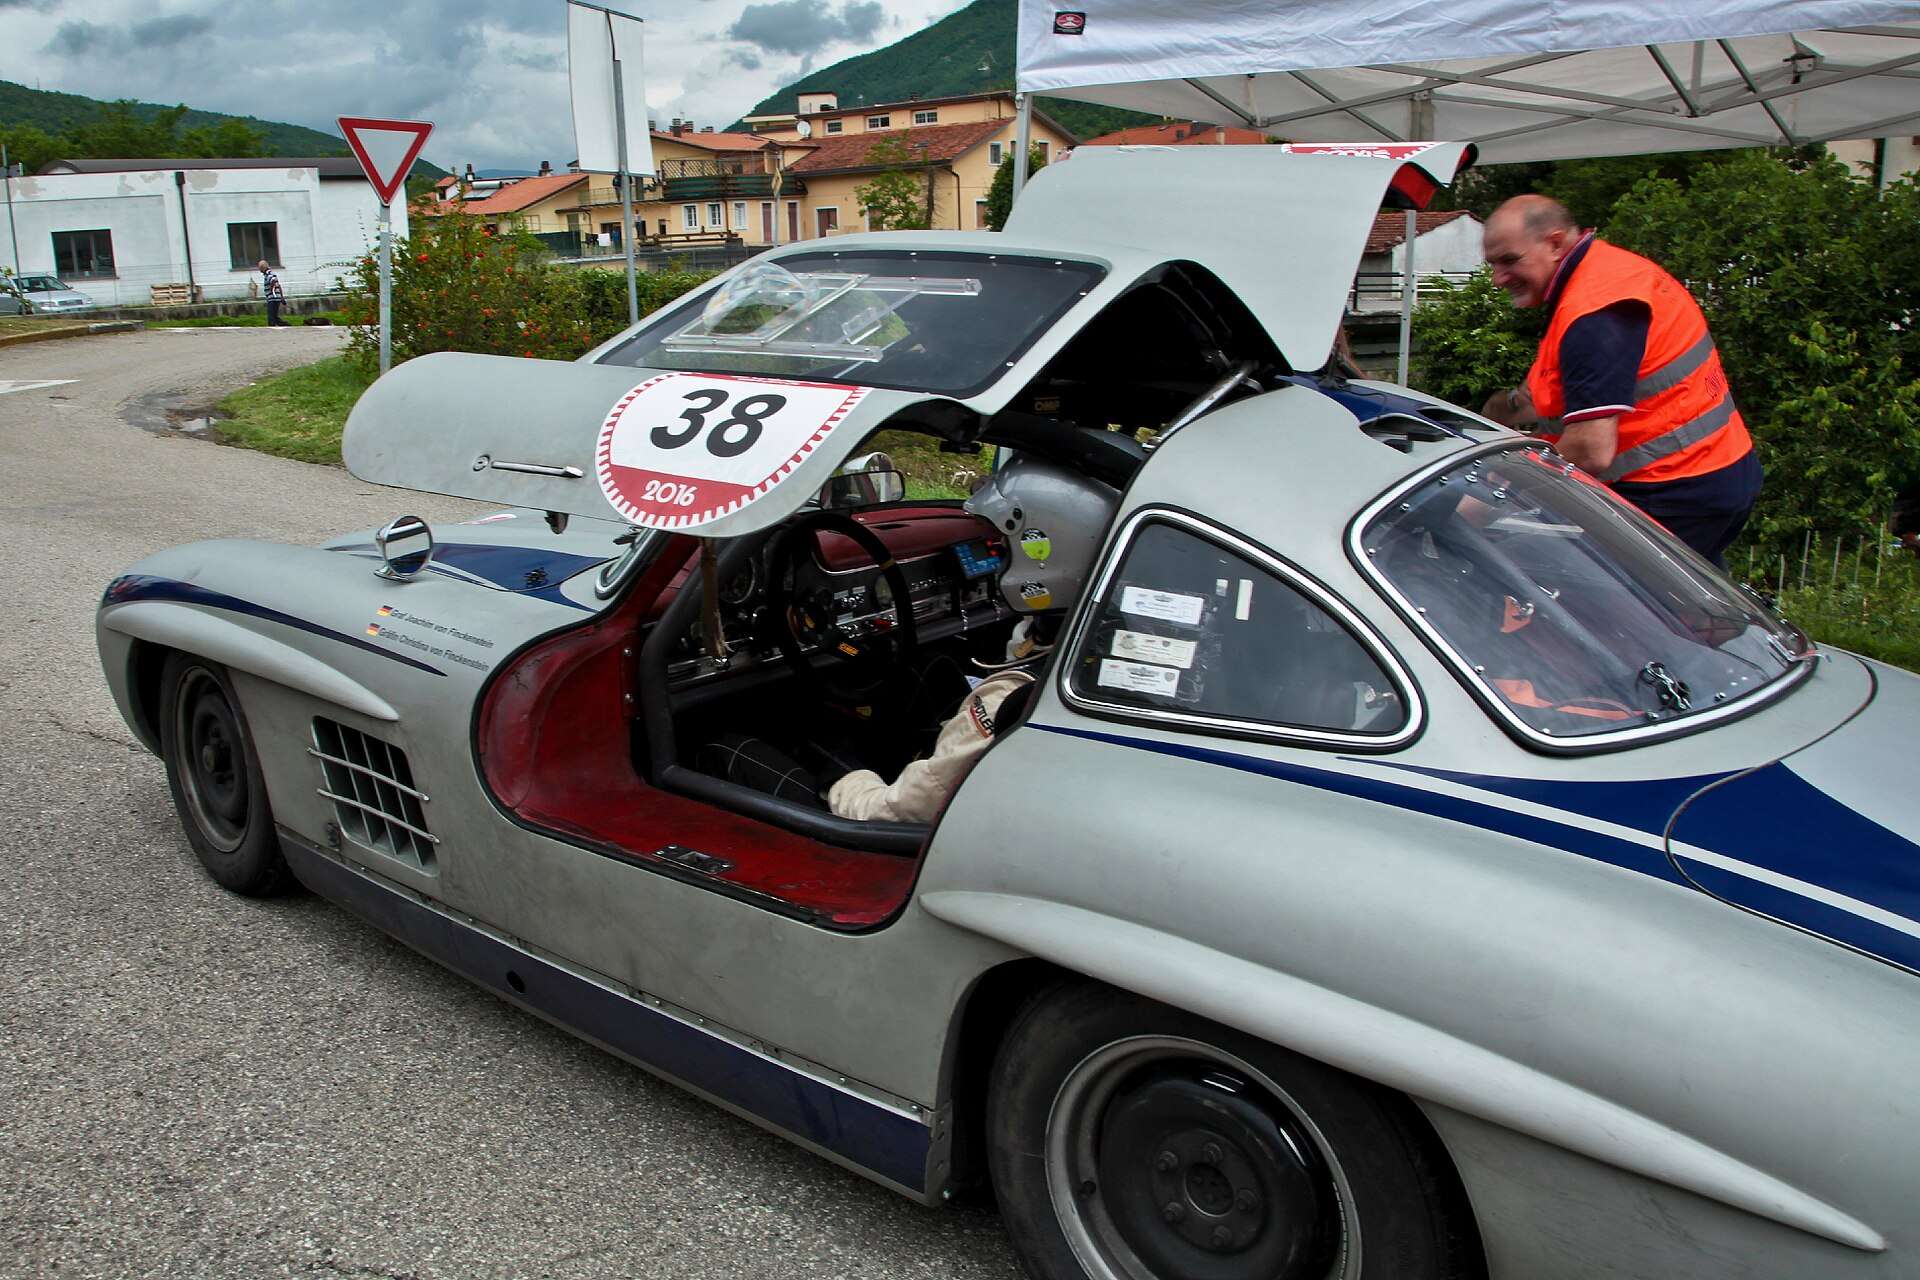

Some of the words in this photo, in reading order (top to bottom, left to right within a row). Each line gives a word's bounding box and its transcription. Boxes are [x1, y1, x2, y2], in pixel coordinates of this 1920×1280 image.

[650, 388, 787, 458] 38
[641, 479, 698, 507] 2016
[434, 624, 448, 634] von
[430, 646, 444, 657] von
